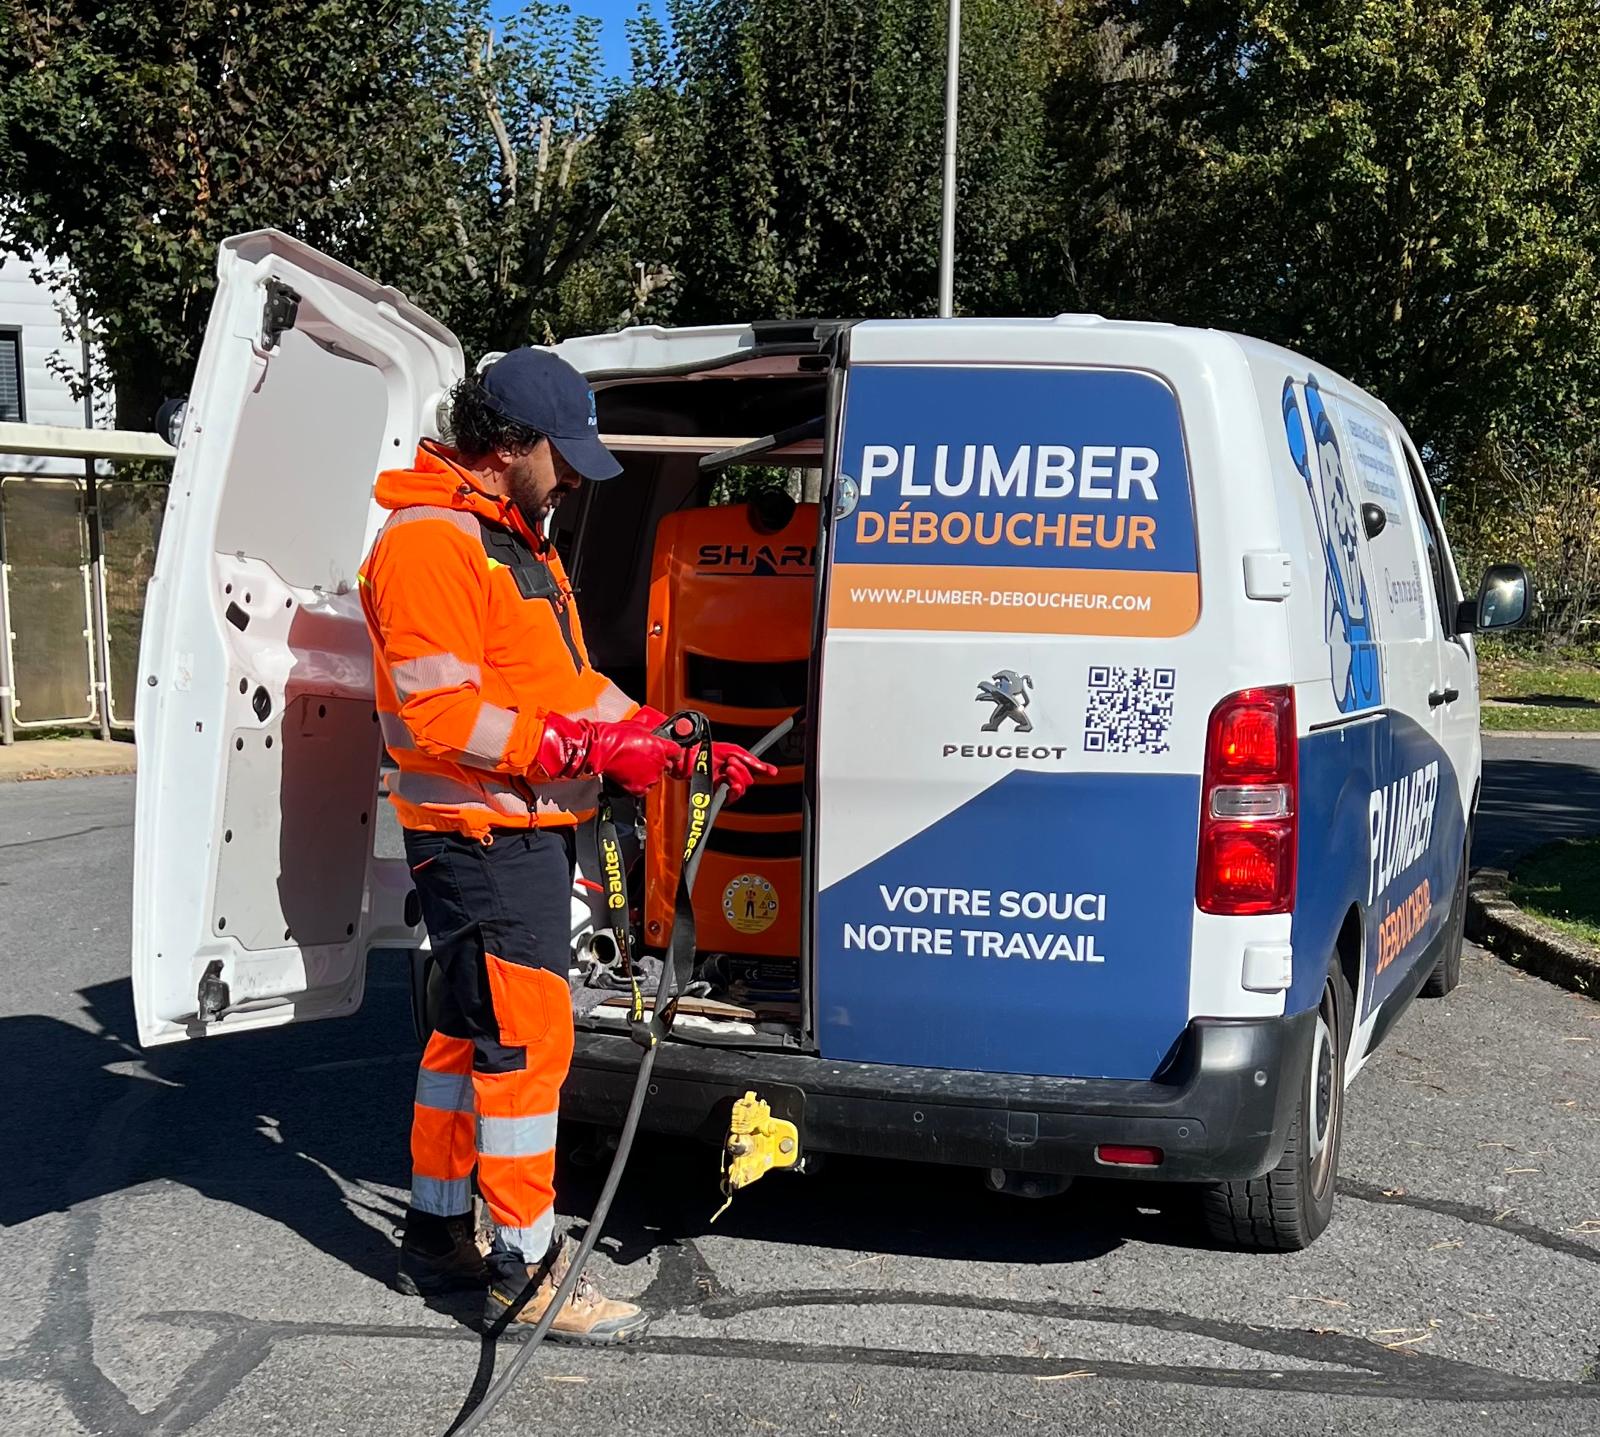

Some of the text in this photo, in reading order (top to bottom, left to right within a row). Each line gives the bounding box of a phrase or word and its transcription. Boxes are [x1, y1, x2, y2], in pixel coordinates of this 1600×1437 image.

[859, 444, 1160, 501] PLUMBER
[855, 502, 1157, 550] DÉBOUCHEUR
[850, 588, 1152, 611] WWW.PLUMBER-DEBOUCHEUR.COM
[942, 743, 1067, 760] PEUGEOT
[684, 808, 706, 862] autec
[1367, 760, 1439, 907] PLUMBER
[603, 840, 623, 893] autec
[879, 885, 1106, 921] VOTRE SOUCI
[843, 923, 1105, 963] NOTRE TRAVAIL
